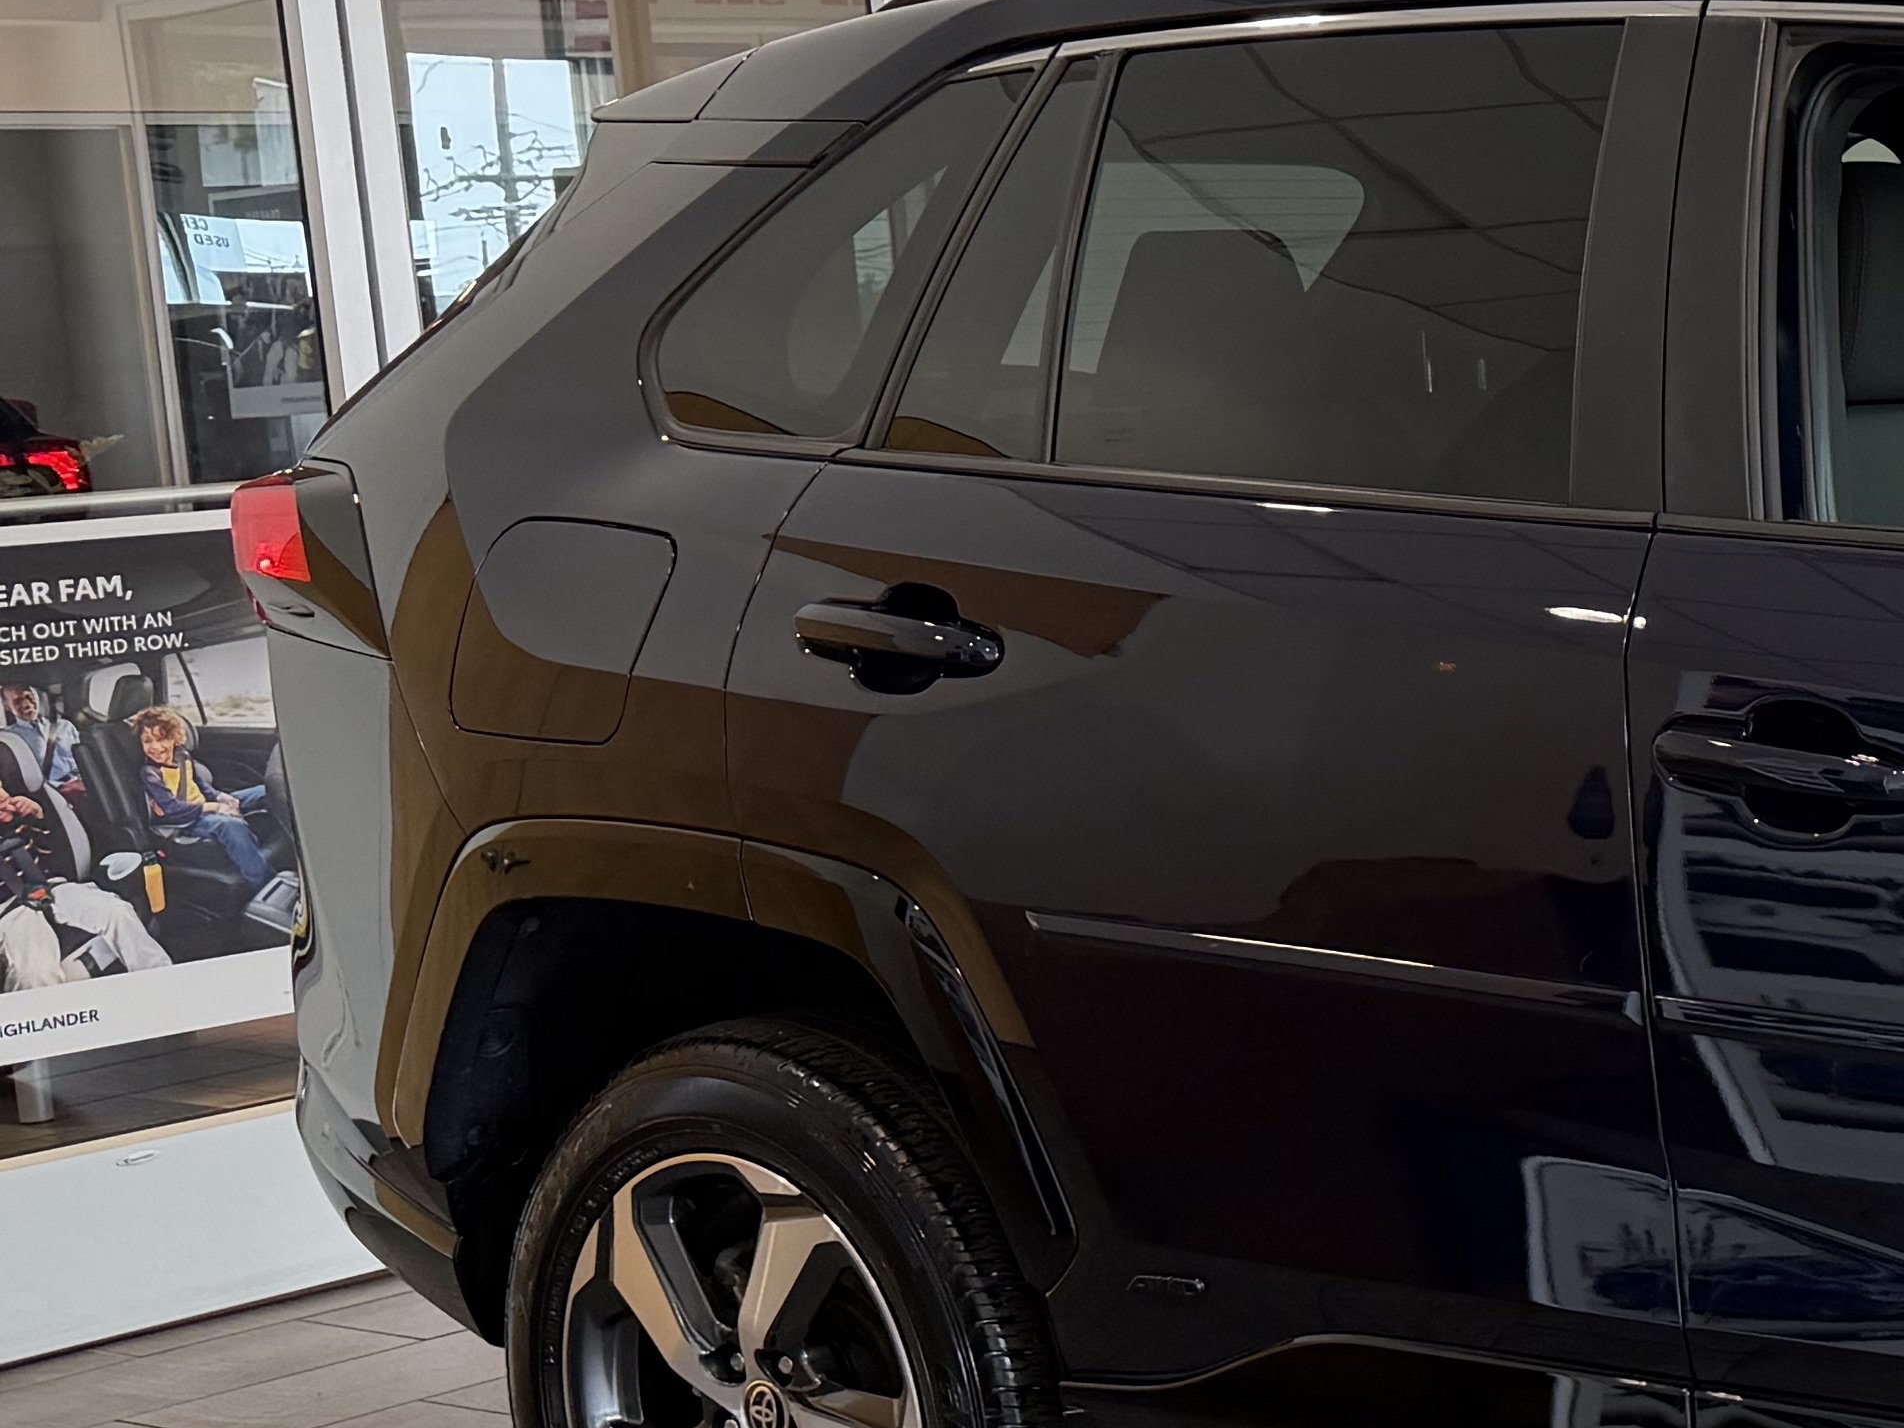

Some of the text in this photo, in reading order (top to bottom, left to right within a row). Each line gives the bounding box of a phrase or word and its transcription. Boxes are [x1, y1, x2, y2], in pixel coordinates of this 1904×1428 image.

[0, 574, 134, 608] EAR FAM,
[0, 610, 173, 643] CH OUT WITH AN
[64, 637, 128, 659] THIRD
[133, 631, 189, 653] ROW.
[0, 1008, 100, 1039] IGHLANDER
